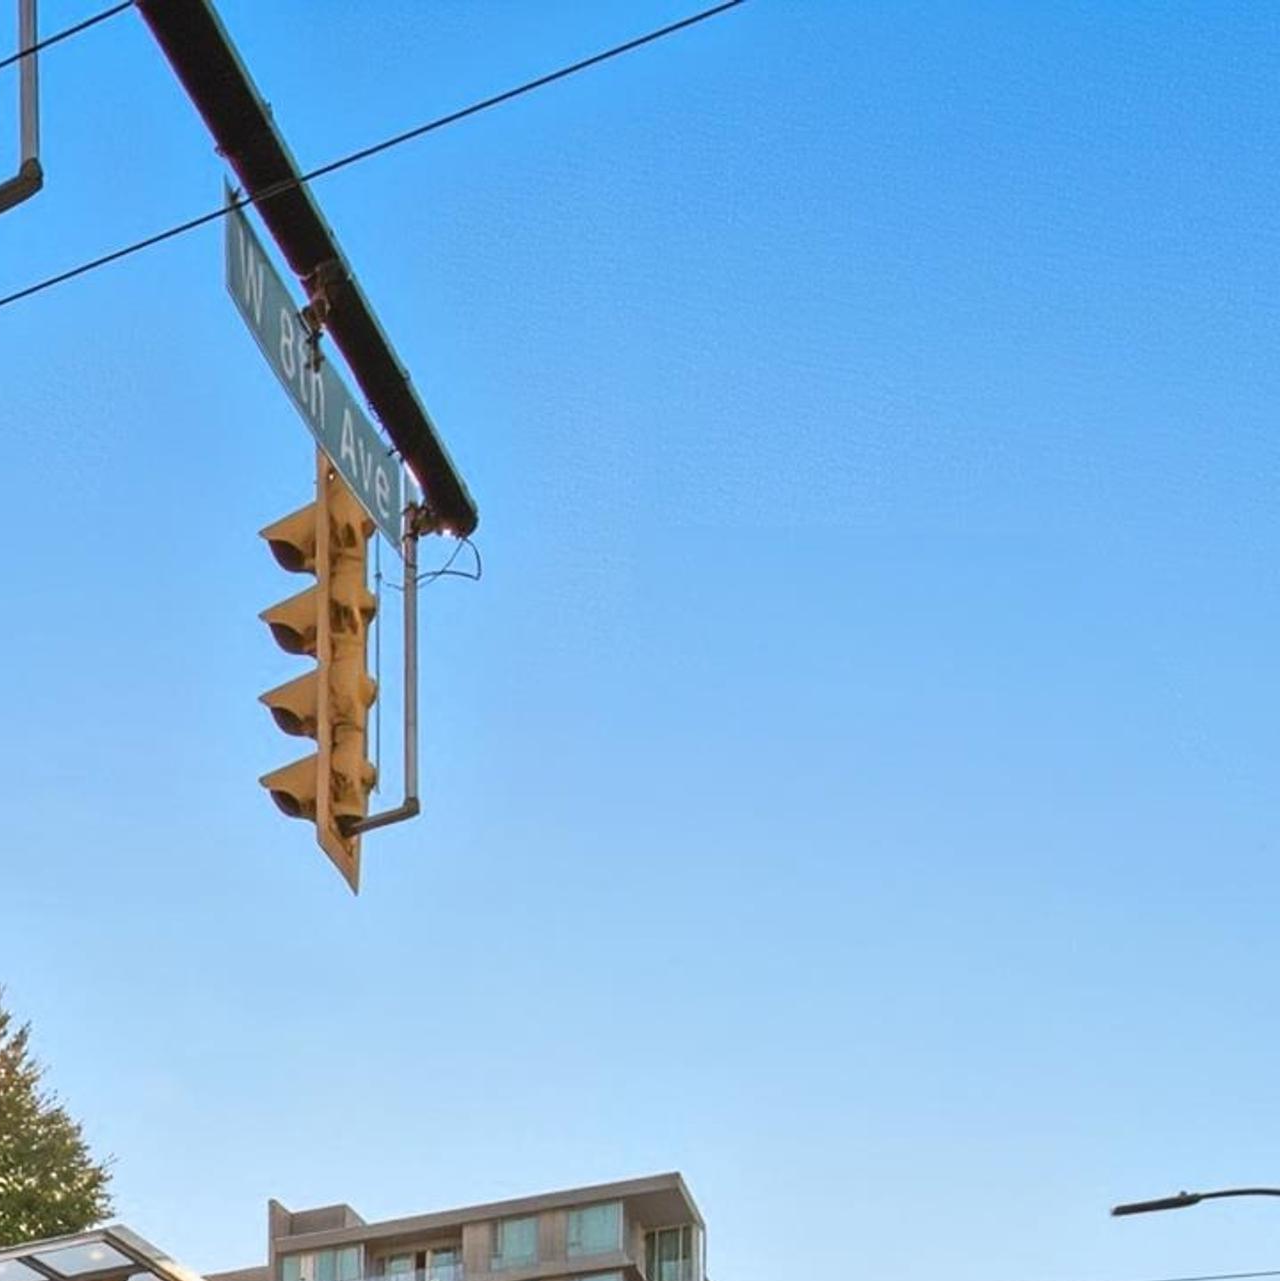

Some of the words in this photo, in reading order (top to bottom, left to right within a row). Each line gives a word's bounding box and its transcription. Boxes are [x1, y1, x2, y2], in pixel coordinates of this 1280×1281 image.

[239, 225, 264, 325] W
[279, 310, 326, 430] 8th
[340, 407, 392, 520] Ave
